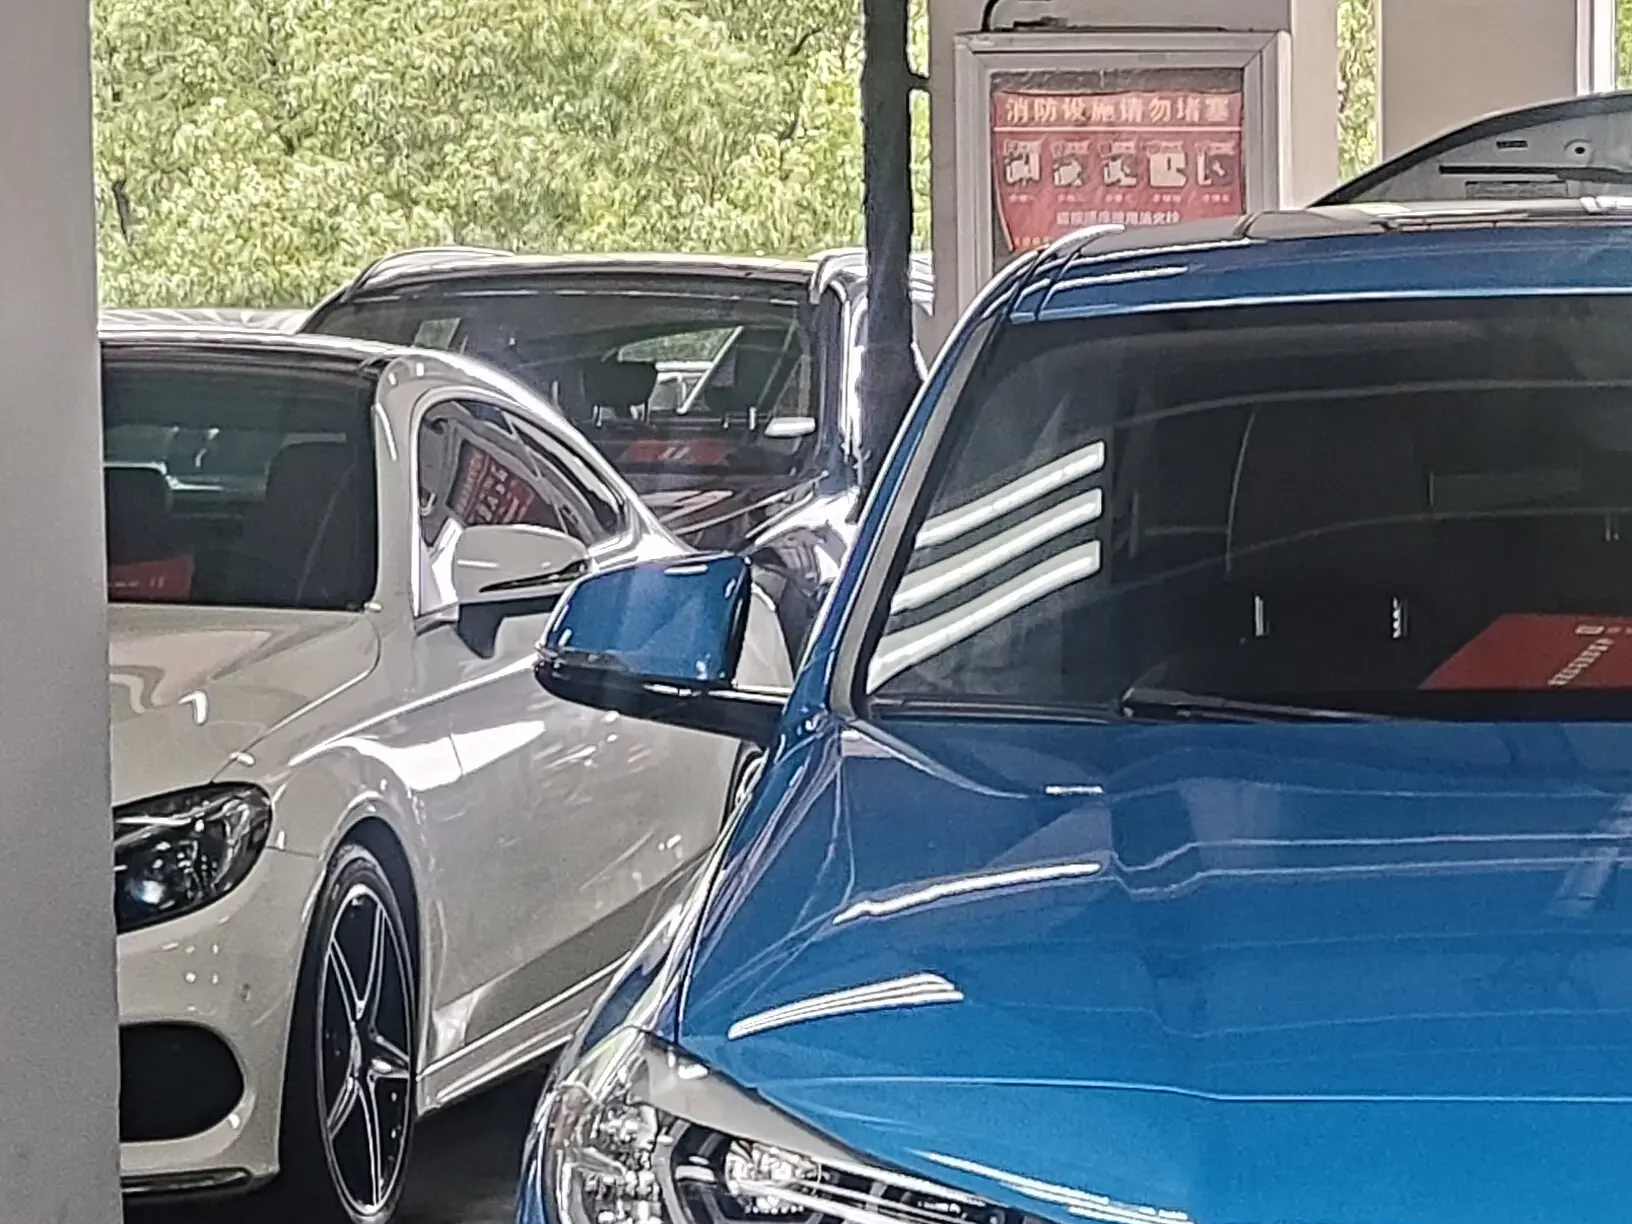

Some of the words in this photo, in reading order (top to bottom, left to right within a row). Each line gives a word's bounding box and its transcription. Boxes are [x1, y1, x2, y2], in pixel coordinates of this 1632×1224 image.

[1005, 96, 1229, 124] 消防设施请勿堵塞
